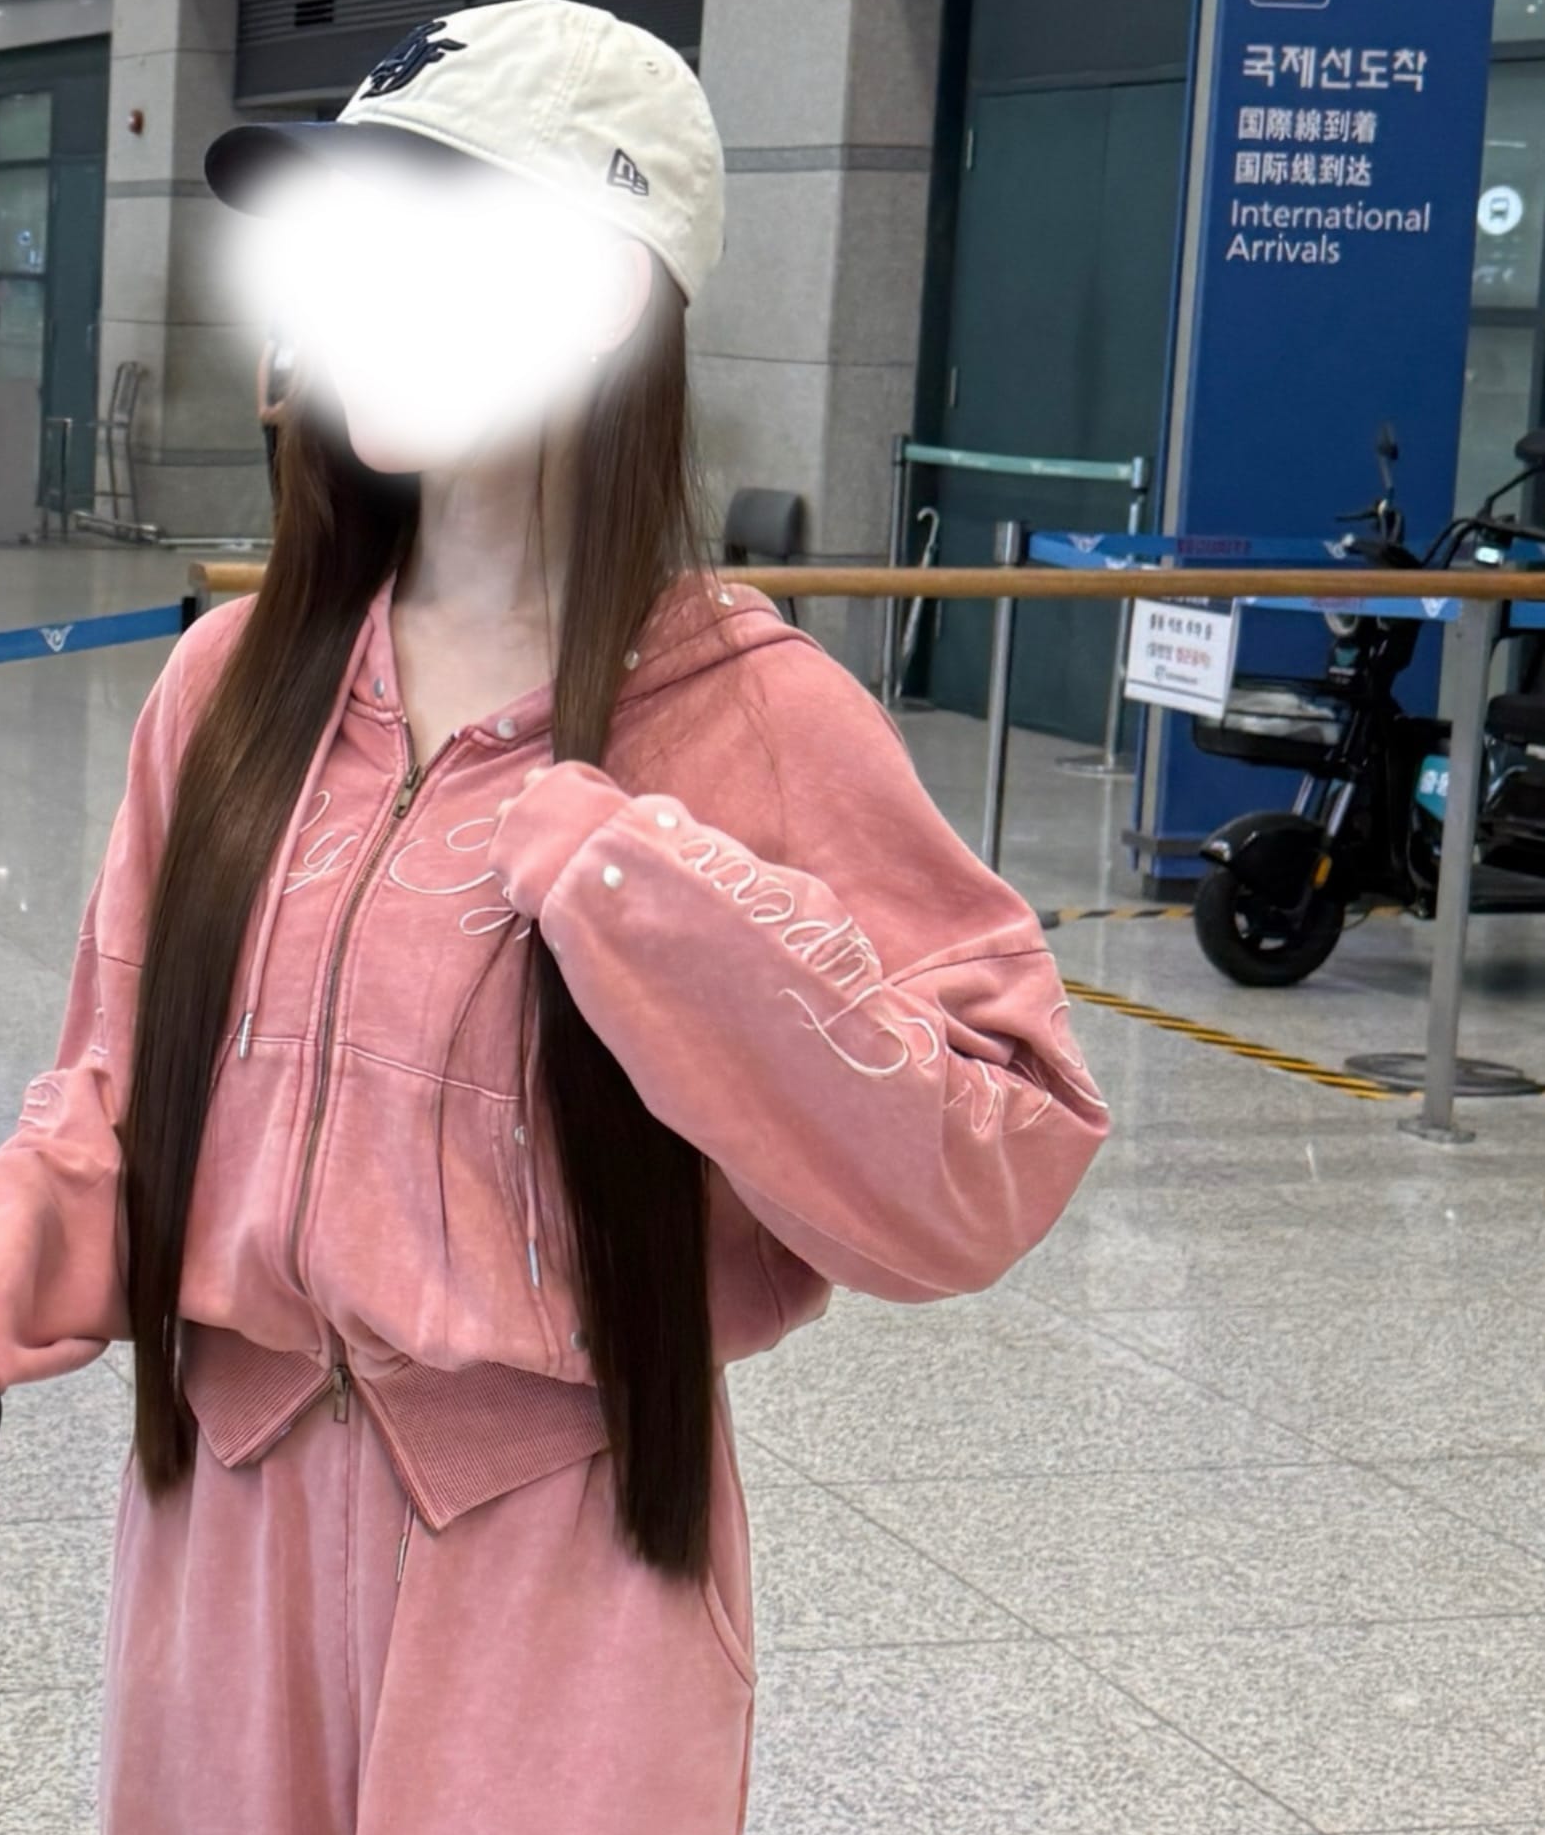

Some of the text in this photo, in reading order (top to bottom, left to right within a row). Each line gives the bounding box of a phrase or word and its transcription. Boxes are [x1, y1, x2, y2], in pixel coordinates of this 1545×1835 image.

[1242, 44, 1427, 92] 국제선도착
[1238, 106, 1377, 143] 国際線到着
[1234, 151, 1372, 187] 国际线到达
[1231, 198, 1431, 233] International
[1225, 232, 1340, 264] Arrivals
